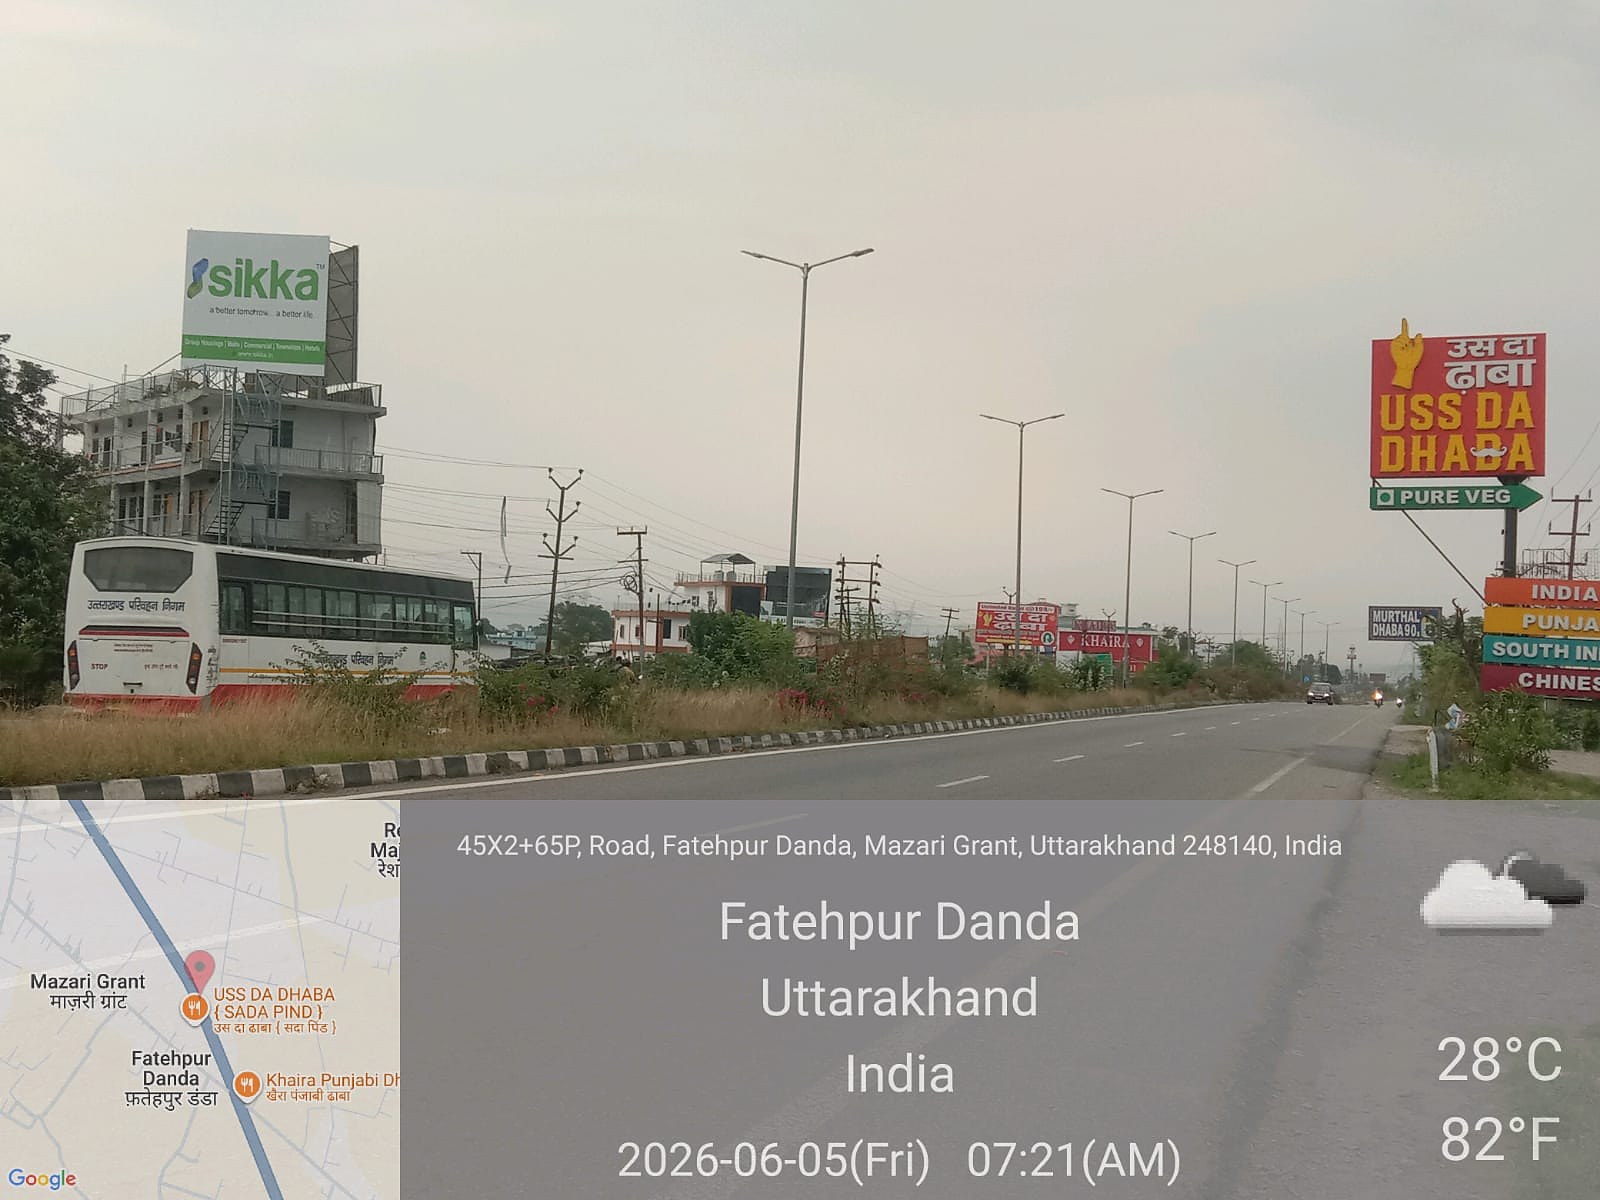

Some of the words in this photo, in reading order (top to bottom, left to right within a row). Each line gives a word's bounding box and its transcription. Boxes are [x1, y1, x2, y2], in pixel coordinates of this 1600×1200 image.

[207, 258, 319, 301] sikka
[1447, 337, 1498, 359] उस
[1502, 335, 1537, 357] दा
[1379, 393, 1463, 432] USS
[1475, 390, 1536, 430] DA
[1379, 432, 1536, 473] DHABA
[1400, 490, 1460, 505] PURE
[1464, 489, 1511, 504] VEG
[1532, 584, 1599, 602] INDIA
[1373, 610, 1420, 623] MURTHAL
[1492, 641, 1568, 659] SOUTH
[1575, 645, 1600, 661] IN
